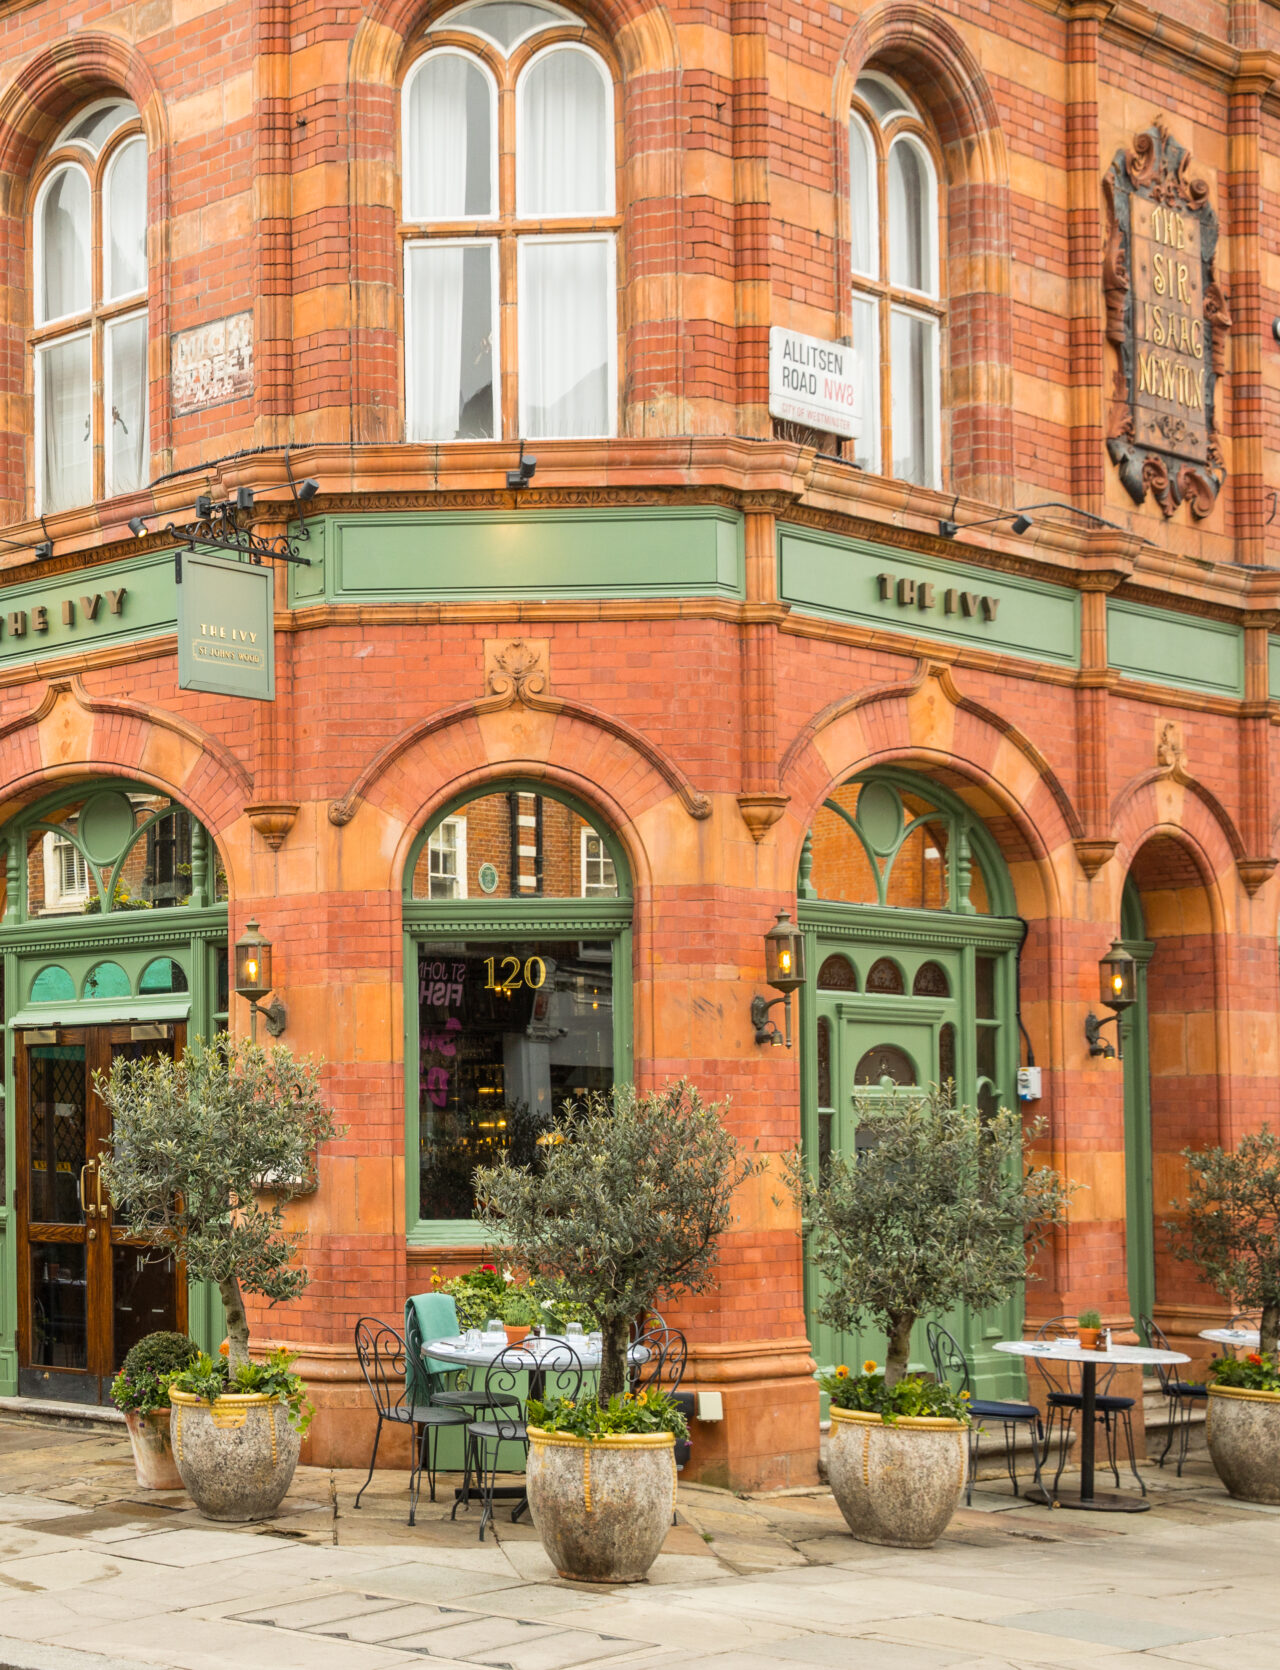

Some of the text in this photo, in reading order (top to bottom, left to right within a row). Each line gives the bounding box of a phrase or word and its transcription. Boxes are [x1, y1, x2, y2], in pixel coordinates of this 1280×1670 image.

[1152, 206, 1185, 249] THE
[1153, 253, 1191, 305] SIR
[1144, 300, 1204, 360] ISAAC
[783, 339, 843, 376] ALLITSEN
[782, 366, 854, 406] ROAD NW8
[1139, 352, 1205, 411] NEWTON
[62, 588, 127, 626] IVY
[876, 573, 1000, 622] THE IVY
[200, 624, 257, 644] THE IVY
[199, 646, 208, 656] ST
[238, 652, 260, 664] WOOD
[483, 956, 547, 989] 120
